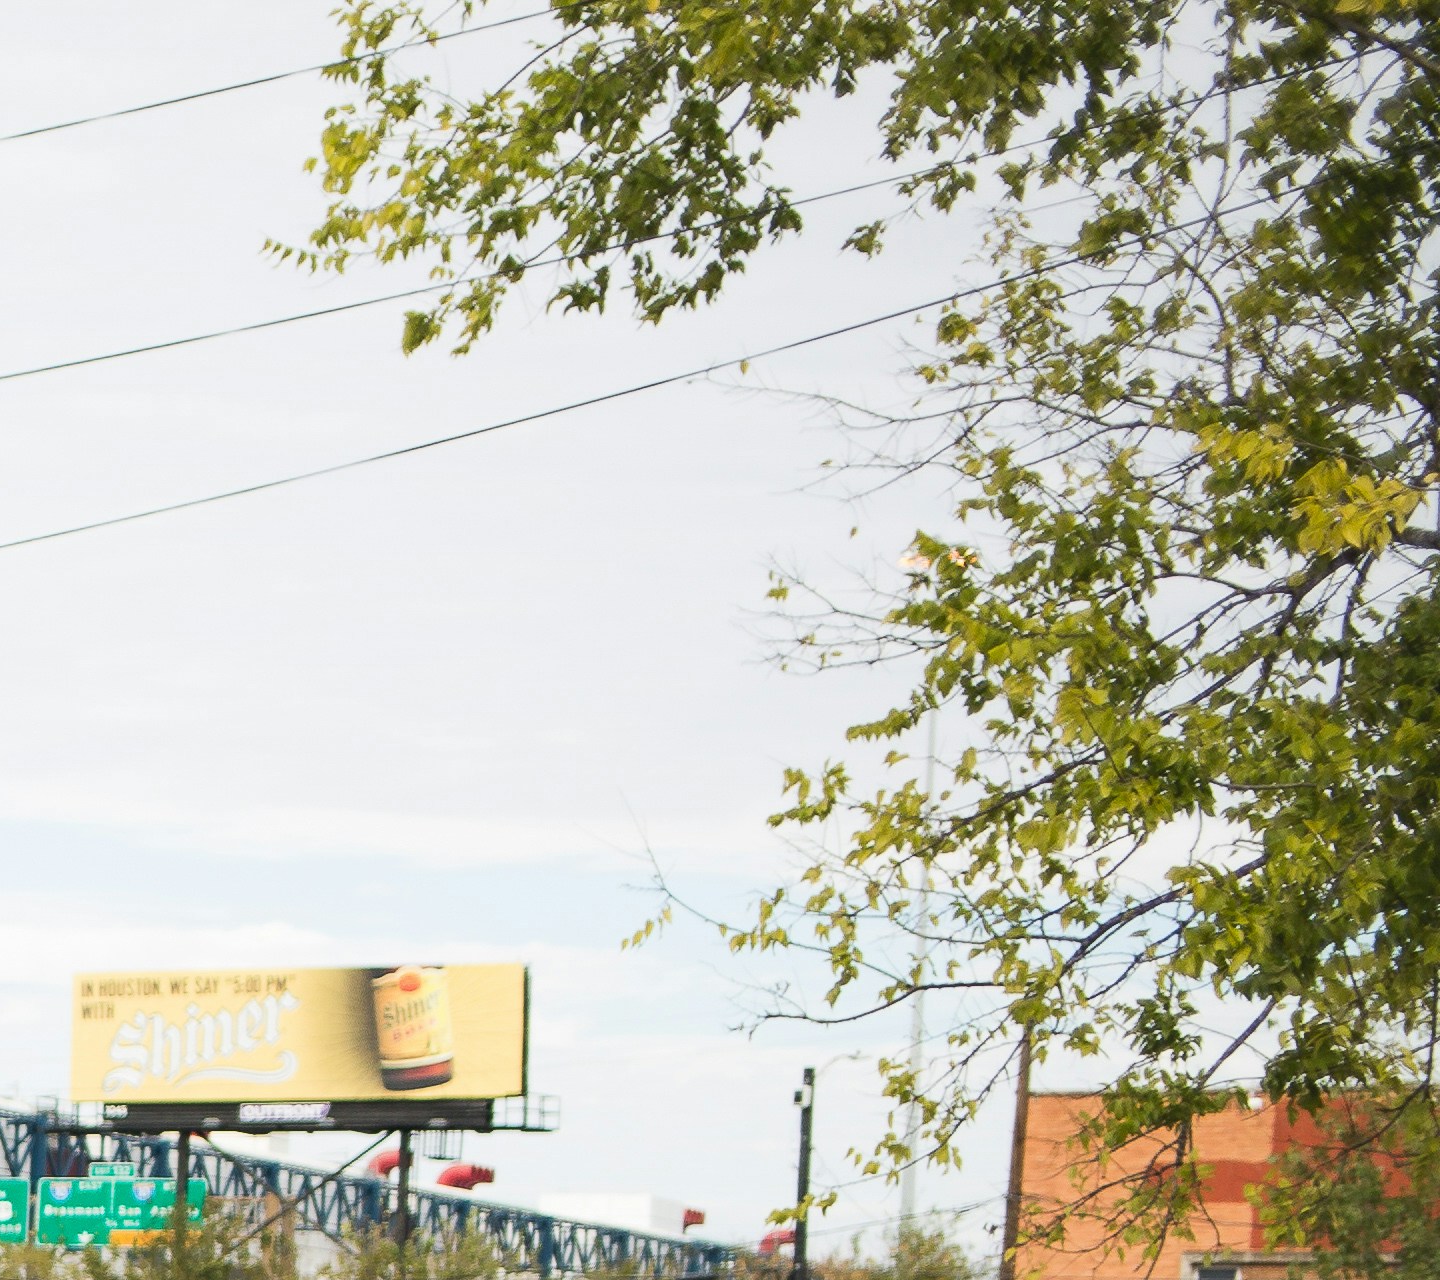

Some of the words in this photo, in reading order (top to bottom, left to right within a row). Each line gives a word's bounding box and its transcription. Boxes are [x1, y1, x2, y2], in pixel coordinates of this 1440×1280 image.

[81, 980, 94, 997] IN
[170, 976, 189, 995] WE
[195, 975, 220, 994] SAY
[82, 1001, 115, 1019] WITH
[101, 990, 300, 1095] Shiner
[44, 1204, 105, 1216] Beaumont
[118, 1204, 141, 1216] San
